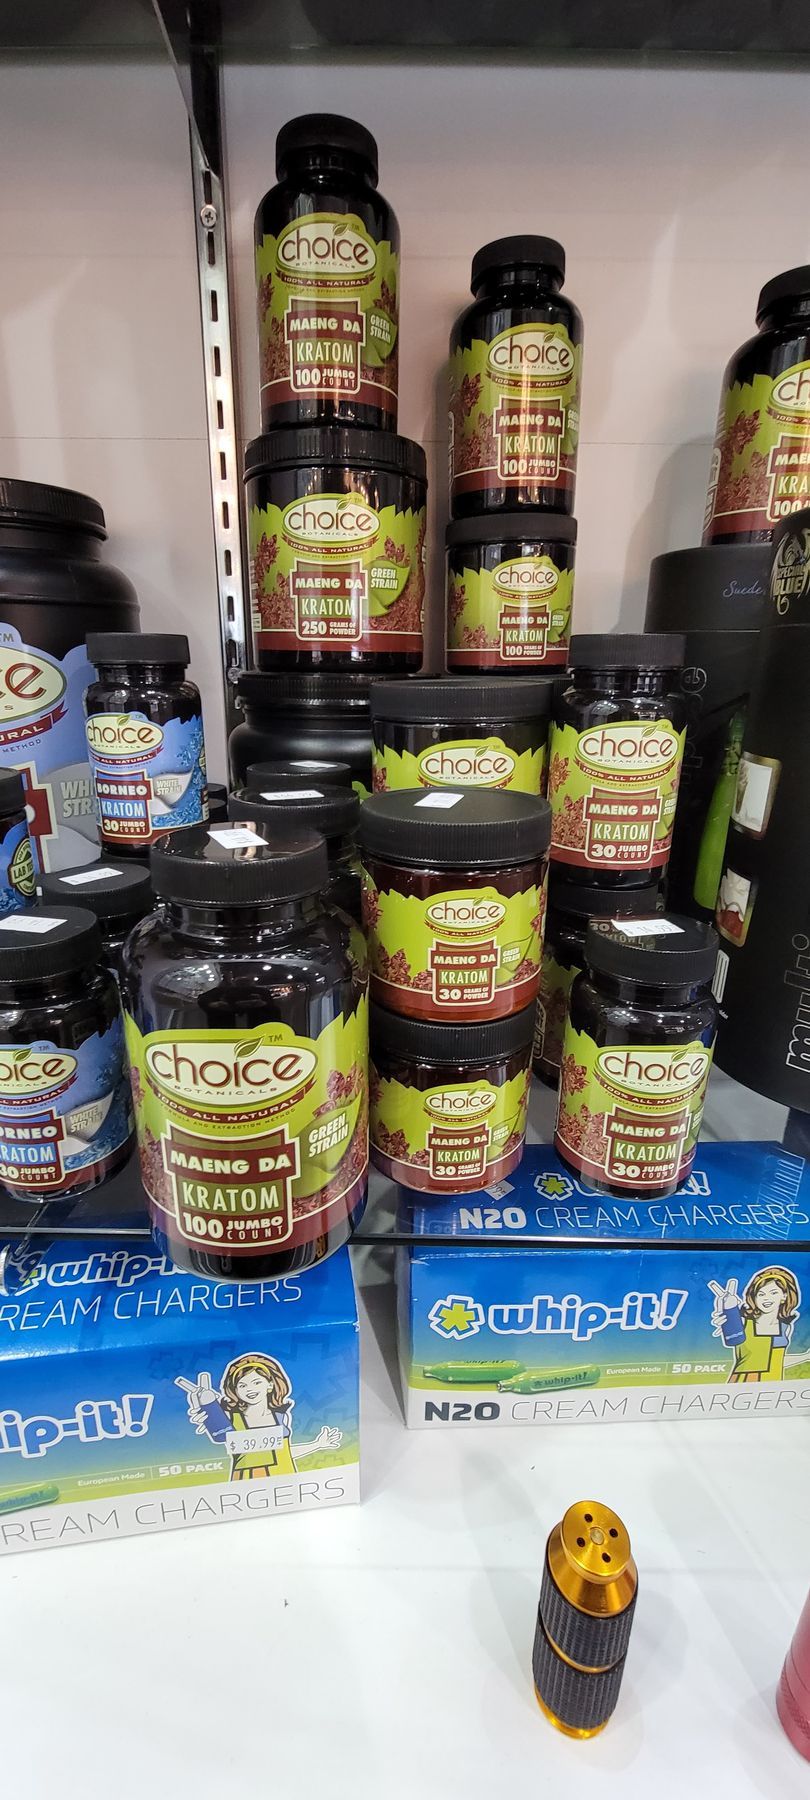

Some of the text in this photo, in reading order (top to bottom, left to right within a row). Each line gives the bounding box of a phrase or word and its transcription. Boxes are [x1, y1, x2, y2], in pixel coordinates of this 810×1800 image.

[281, 228, 369, 266] choice
[290, 317, 361, 334] MAENG DA
[370, 314, 390, 332] GREEN
[370, 327, 391, 344] STRAIN
[296, 341, 354, 364] KRATOM
[493, 335, 570, 368] choice
[295, 368, 321, 386] 100
[322, 368, 356, 379] JUMBO
[322, 376, 355, 388] COUNT
[499, 414, 545, 428] MAENG
[547, 415, 562, 428] DA
[505, 435, 555, 454] KRATOM
[502, 459, 528, 475] 100
[528, 459, 556, 468] JUMBO
[288, 504, 373, 532] choice
[330, 543, 371, 553] NATURAL
[370, 567, 396, 579] GREEN
[498, 566, 555, 584] choice
[295, 577, 363, 590] MAENG DA
[370, 579, 398, 590] STRAIN
[722, 579, 763, 598] Suede
[302, 598, 356, 616] KRATOM
[301, 620, 327, 635] 250
[501, 617, 535, 625] MAENG
[536, 617, 548, 625] DA
[329, 628, 356, 636] POWDER
[506, 630, 543, 643] KRATOM
[505, 645, 523, 656] 100
[86, 719, 155, 744] choice
[583, 731, 673, 758] choice
[115, 754, 153, 764] NATURAL
[425, 751, 508, 775] choice
[582, 766, 605, 779] 100%
[629, 769, 669, 781] NATURAL
[97, 782, 148, 796] BORNEO
[156, 779, 180, 788] WHITE
[102, 801, 145, 818] KRATOM
[588, 803, 638, 816] MAENG
[642, 804, 658, 816] DA
[104, 820, 120, 832] 30
[120, 820, 146, 828] JUMBO
[593, 822, 649, 840] KRATOM
[591, 844, 617, 858] 30
[618, 844, 648, 853] JUMBO
[13, 865, 26, 880] LAB
[431, 902, 501, 921] choice
[433, 954, 497, 965] MAENG DA
[440, 970, 488, 985] KRATOM
[438, 988, 462, 1000] 30
[463, 992, 489, 1000] POWDER
[268, 1033, 283, 1043] TM
[150, 1043, 304, 1088] choice
[603, 1053, 705, 1082] choice
[174, 1085, 278, 1096] BOTANICALS
[620, 1079, 691, 1088] BOTANICALS
[12, 1088, 65, 1106] NATURAL
[429, 1093, 492, 1109] choice
[603, 1083, 629, 1100] 100%
[632, 1097, 652, 1105] ALL
[69, 1105, 99, 1124] WHITE
[157, 1092, 299, 1121] 100% ALL NATURAL
[308, 1114, 347, 1145] GREEN
[609, 1121, 686, 1138] MAENG DA
[308, 1125, 349, 1158] STRAIN
[430, 1137, 471, 1146] MAENG
[473, 1134, 488, 1144] DA
[0, 1145, 55, 1163] RATOM
[437, 1148, 480, 1162] KRATOM
[615, 1142, 677, 1161] KRATOM
[20, 1166, 56, 1175] JUMBO
[169, 1150, 292, 1175] MAENG DA
[435, 1165, 456, 1176] 30
[612, 1162, 641, 1178] 30
[642, 1163, 675, 1173] JUMBO
[182, 1181, 280, 1212] KRATOM
[226, 1215, 284, 1231] JUMBO
[535, 1206, 640, 1229] CREAM
[647, 1203, 810, 1226] CHARGERS
[182, 1212, 224, 1239] 100
[227, 1225, 283, 1240] COUNT
[113, 1278, 302, 1320] CHARGERS
[489, 1288, 689, 1341] whip-it!
[606, 1367, 640, 1375] European
[672, 1363, 692, 1374] 50
[694, 1364, 726, 1373] PACK
[511, 1396, 628, 1421] CREAM
[230, 1436, 276, 1452] $ 39.99
[78, 1461, 224, 1487] European Made 50 PACK
[136, 1476, 346, 1525] CHARGERS
